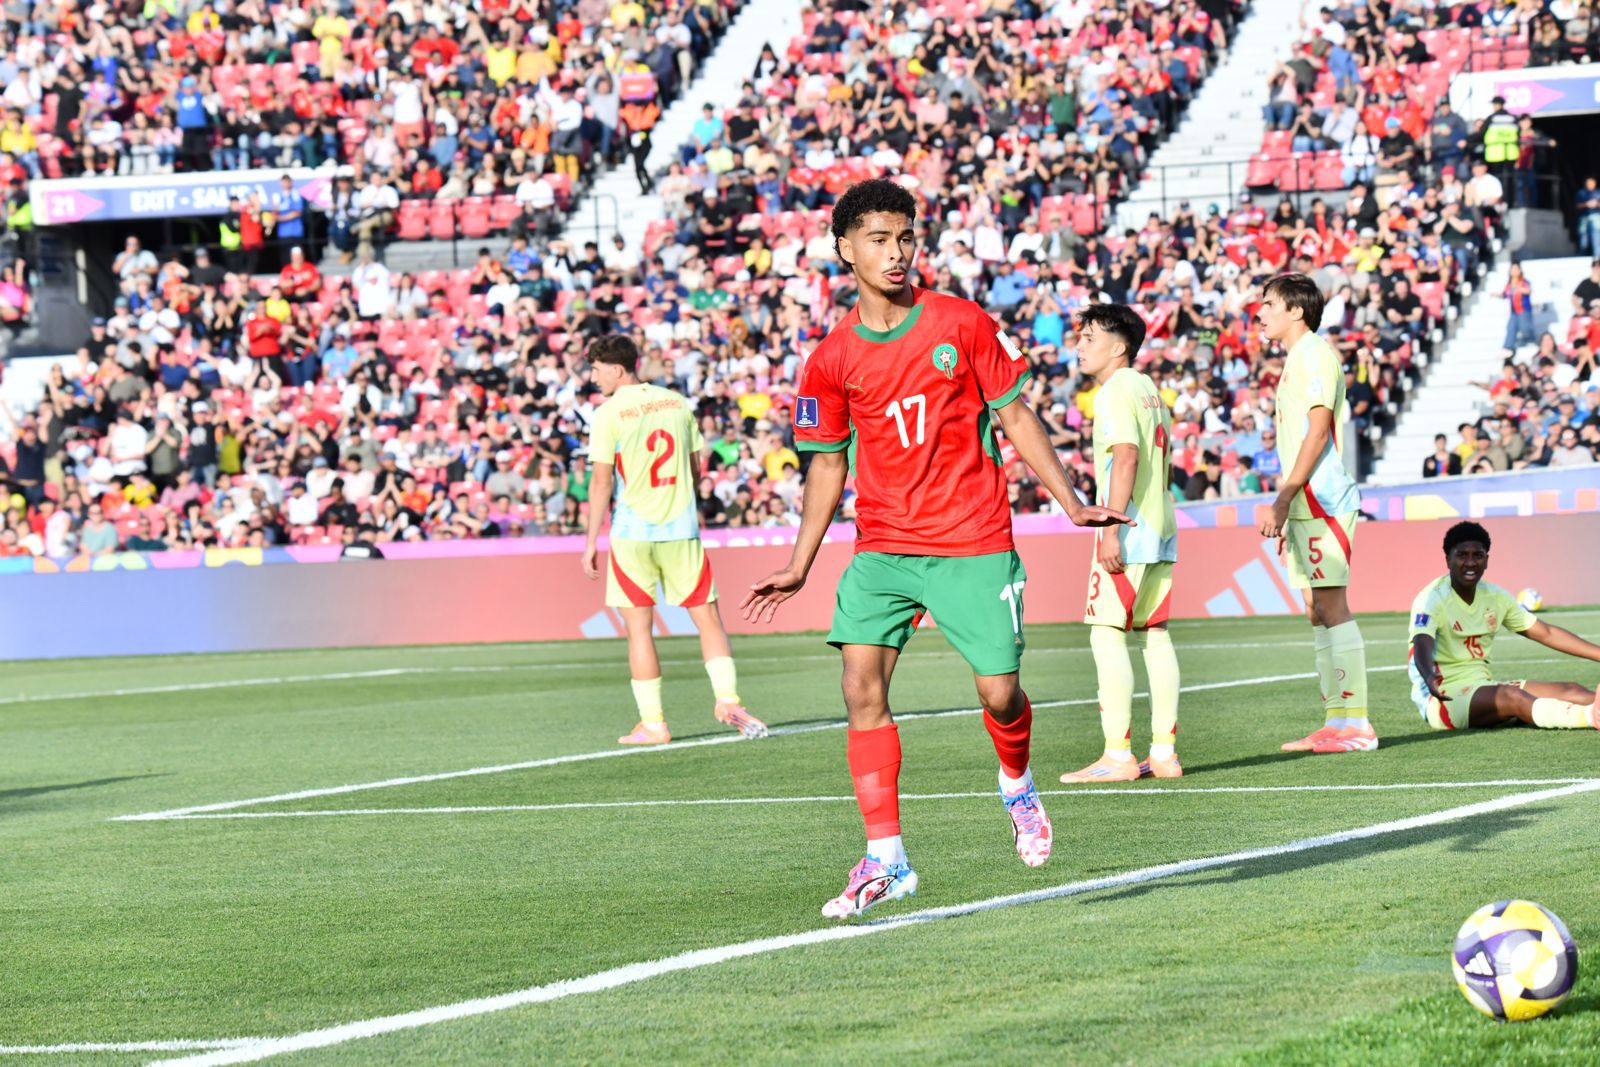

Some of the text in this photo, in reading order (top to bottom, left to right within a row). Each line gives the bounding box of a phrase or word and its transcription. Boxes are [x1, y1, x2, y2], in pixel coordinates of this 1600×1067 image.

[1503, 86, 1532, 109] 20
[50, 194, 76, 217] 21
[130, 188, 178, 213] EXIT
[885, 393, 926, 449] 17
[646, 428, 677, 489] 2
[1308, 536, 1323, 565] 5
[1463, 633, 1485, 660] 15
